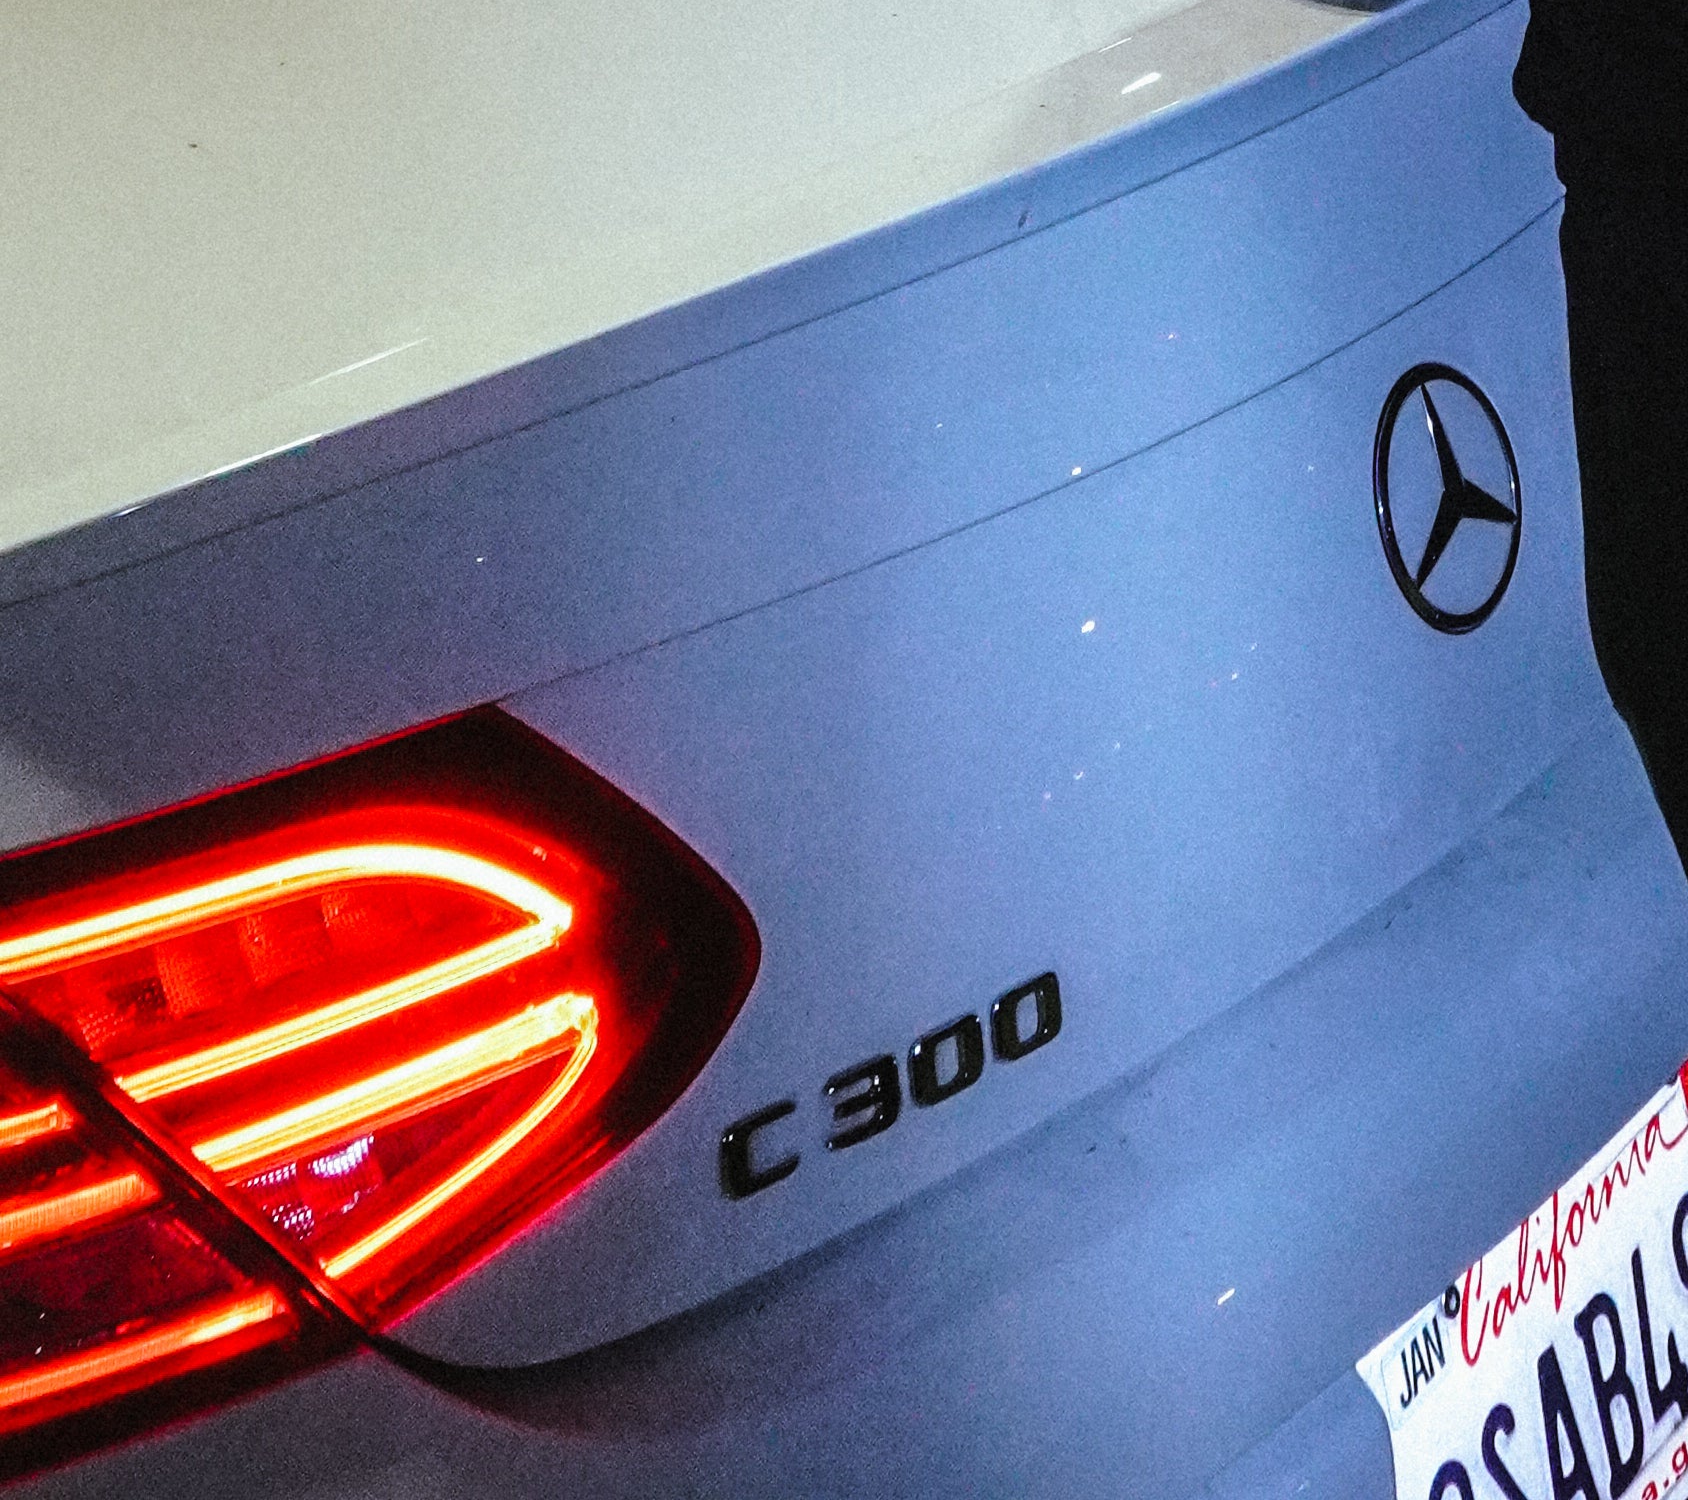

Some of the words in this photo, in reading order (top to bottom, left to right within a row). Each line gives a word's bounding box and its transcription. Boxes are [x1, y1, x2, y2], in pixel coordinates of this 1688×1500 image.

[717, 1098, 802, 1202] C
[823, 970, 1065, 1153] 300
[1399, 1317, 1447, 1410] JAN
